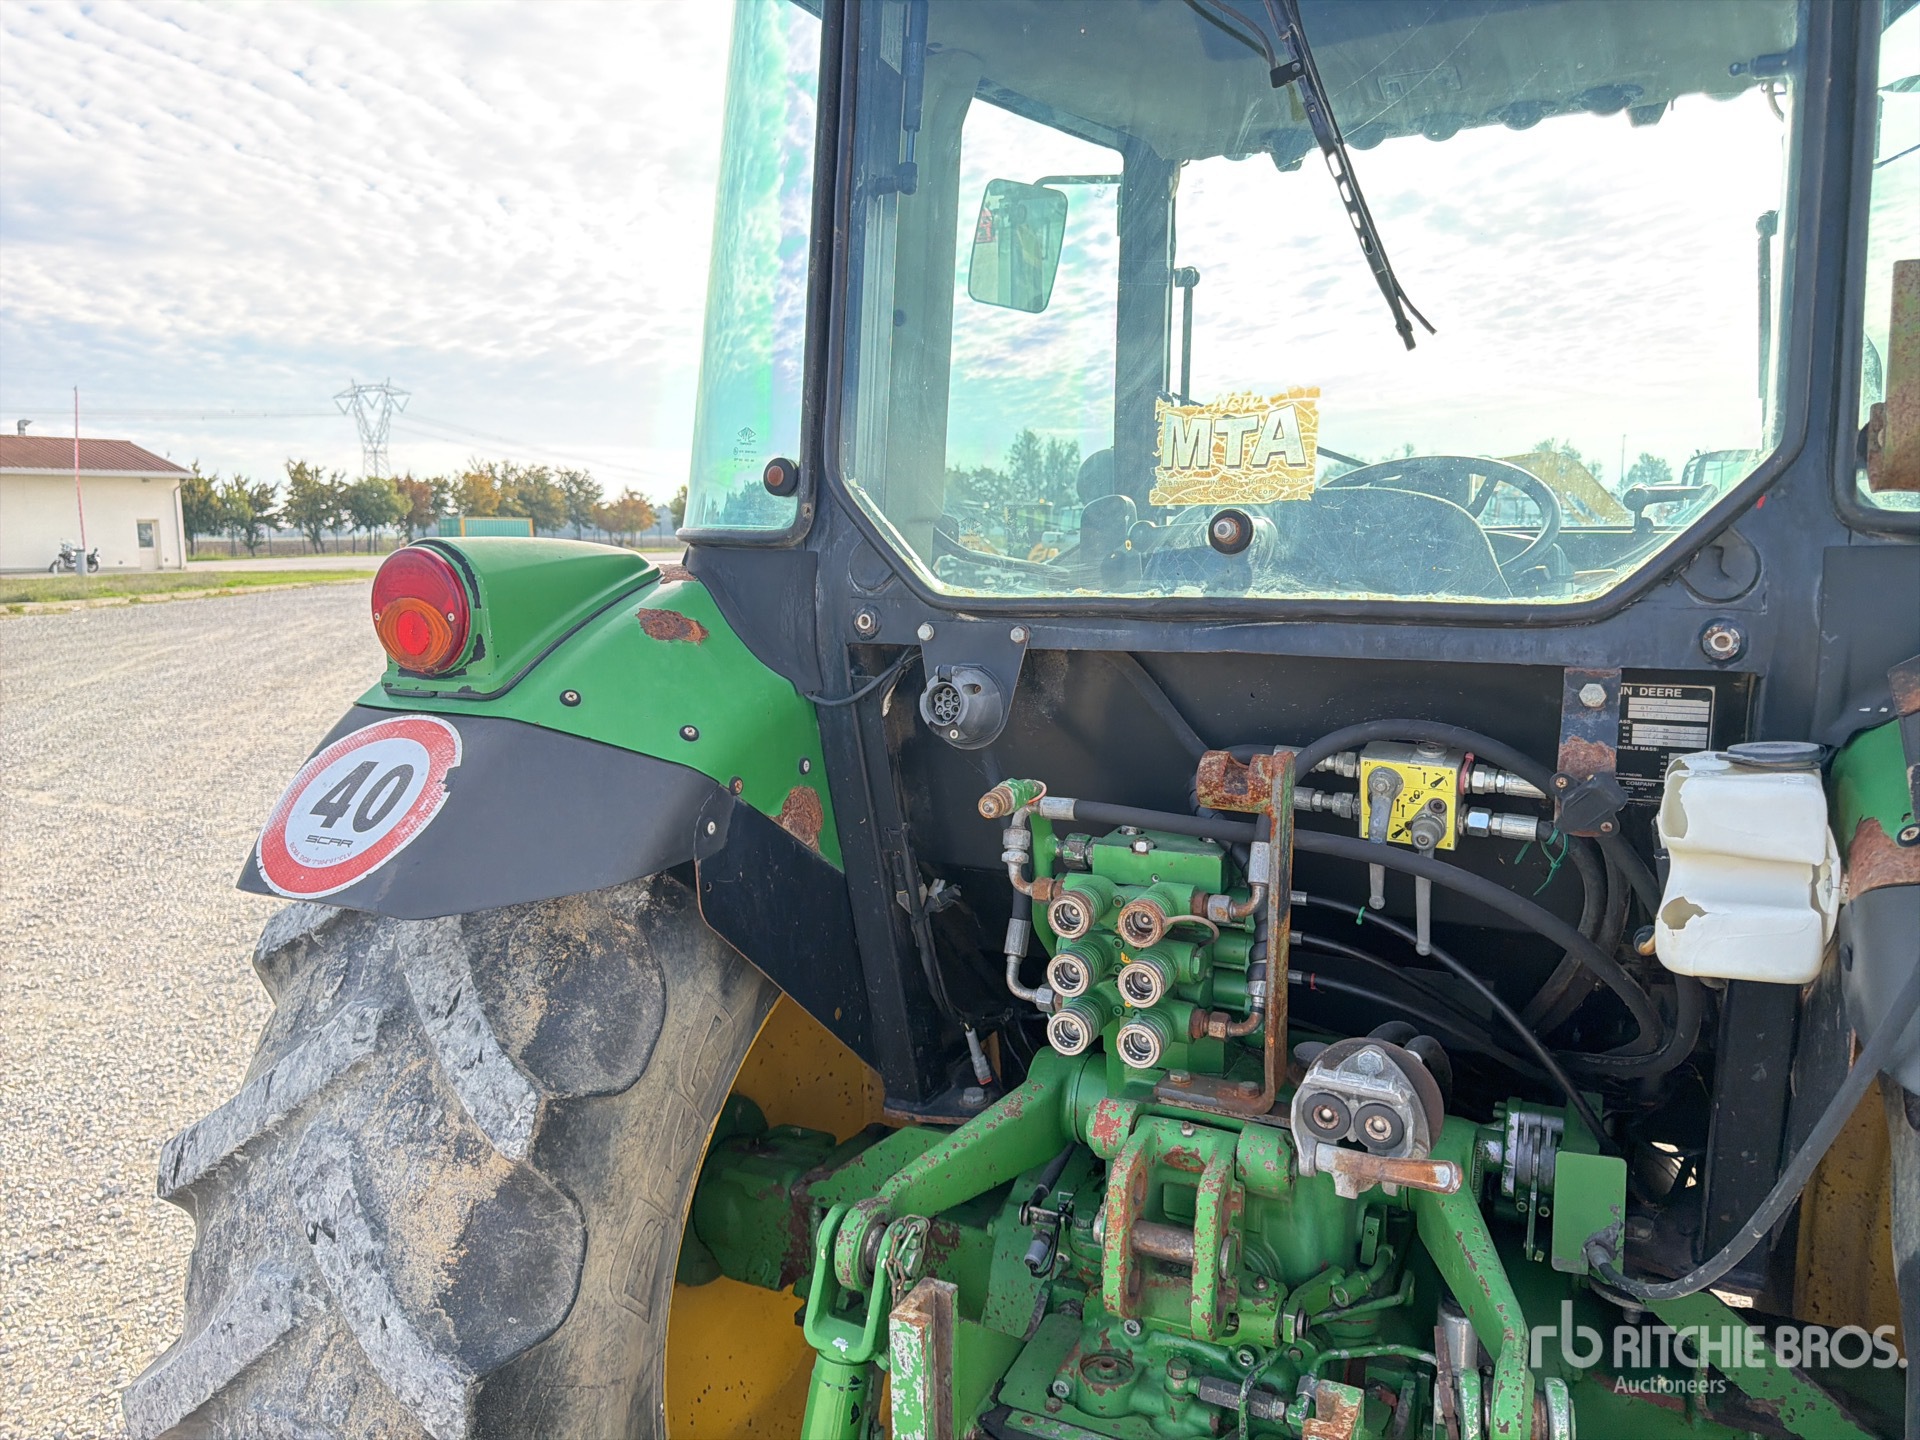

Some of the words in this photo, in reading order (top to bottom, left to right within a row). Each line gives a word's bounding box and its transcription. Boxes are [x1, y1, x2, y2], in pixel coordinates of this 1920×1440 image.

[1161, 403, 1307, 470] MTA
[1639, 687, 1682, 698] DEERE
[309, 760, 415, 833] 40
[305, 834, 354, 848] SCAR
